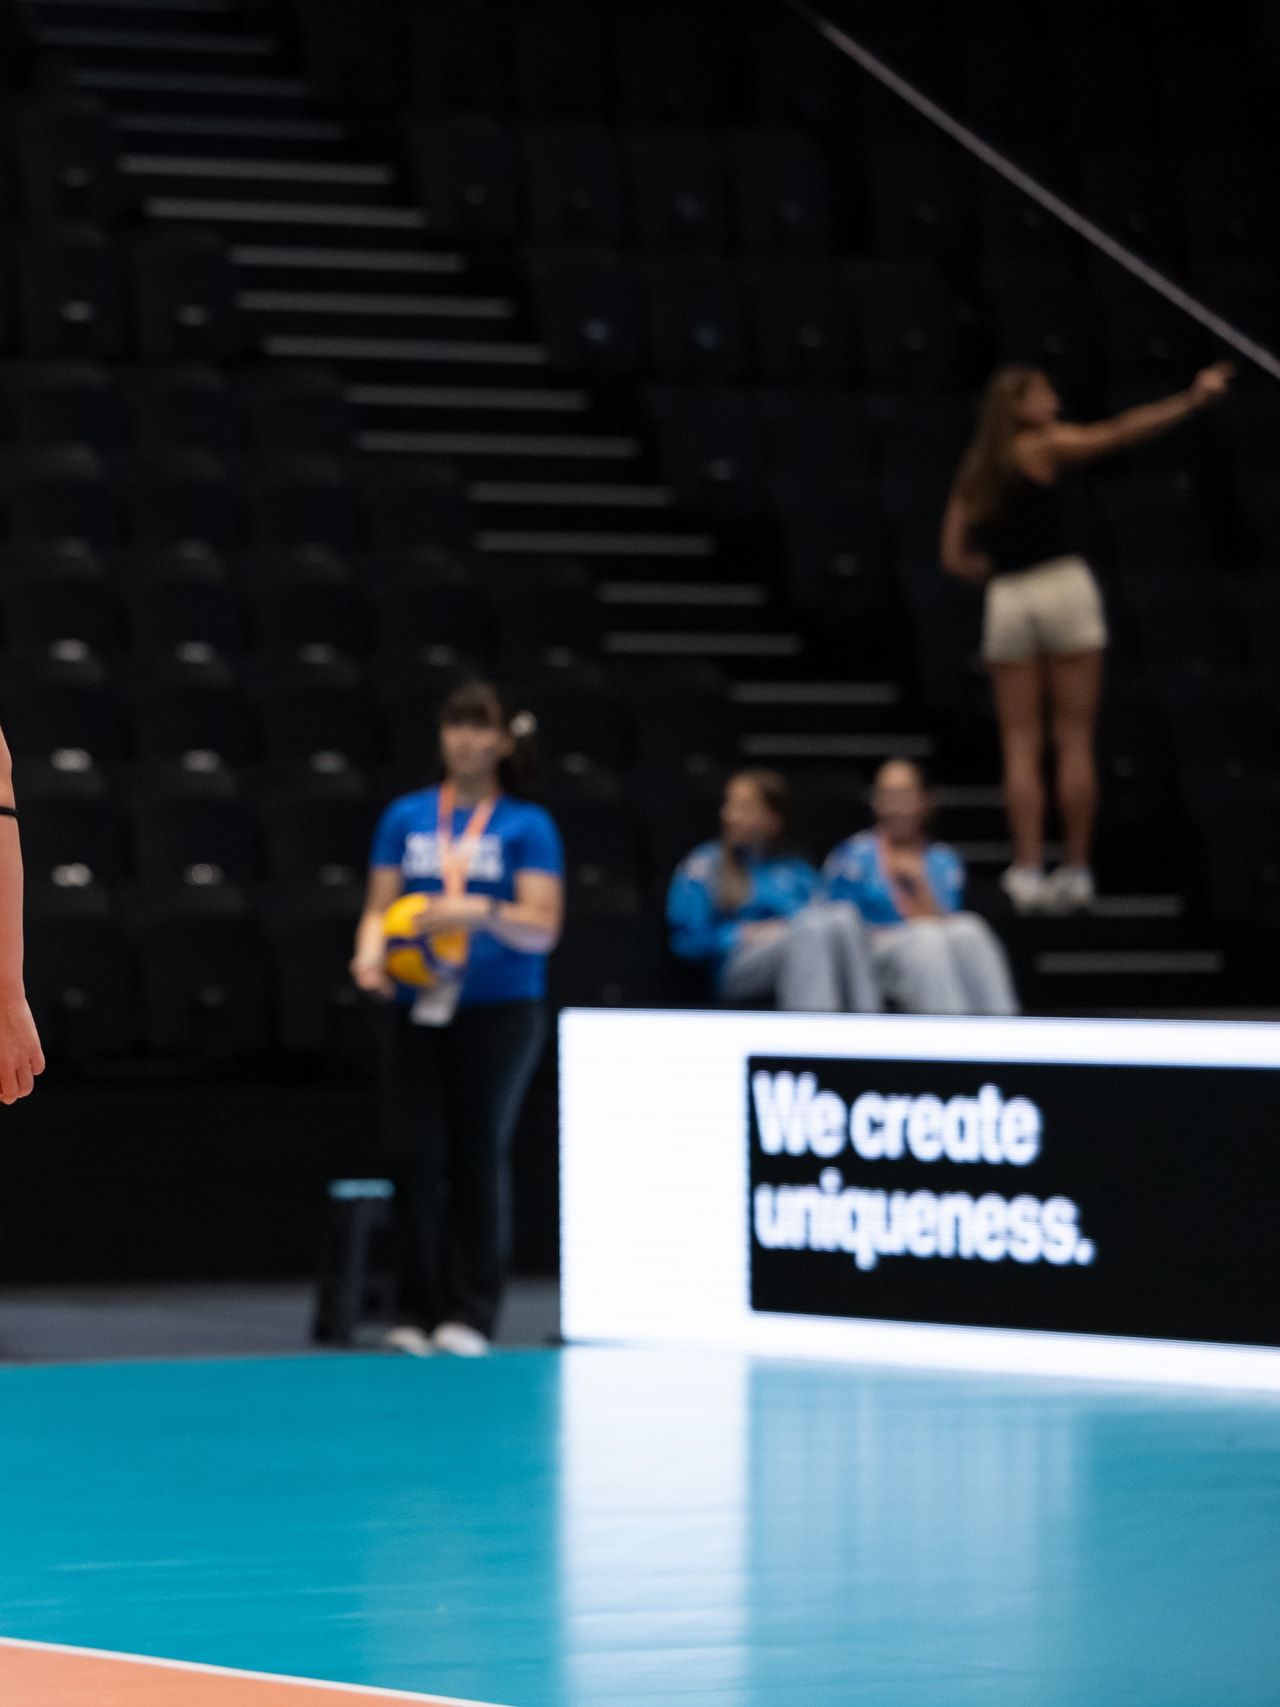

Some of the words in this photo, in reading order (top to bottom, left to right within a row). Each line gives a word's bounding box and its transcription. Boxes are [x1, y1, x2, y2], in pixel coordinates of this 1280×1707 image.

[753, 1069, 848, 1158] We
[849, 1083, 1042, 1166] create
[754, 1166, 1096, 1271] uniqueness.
